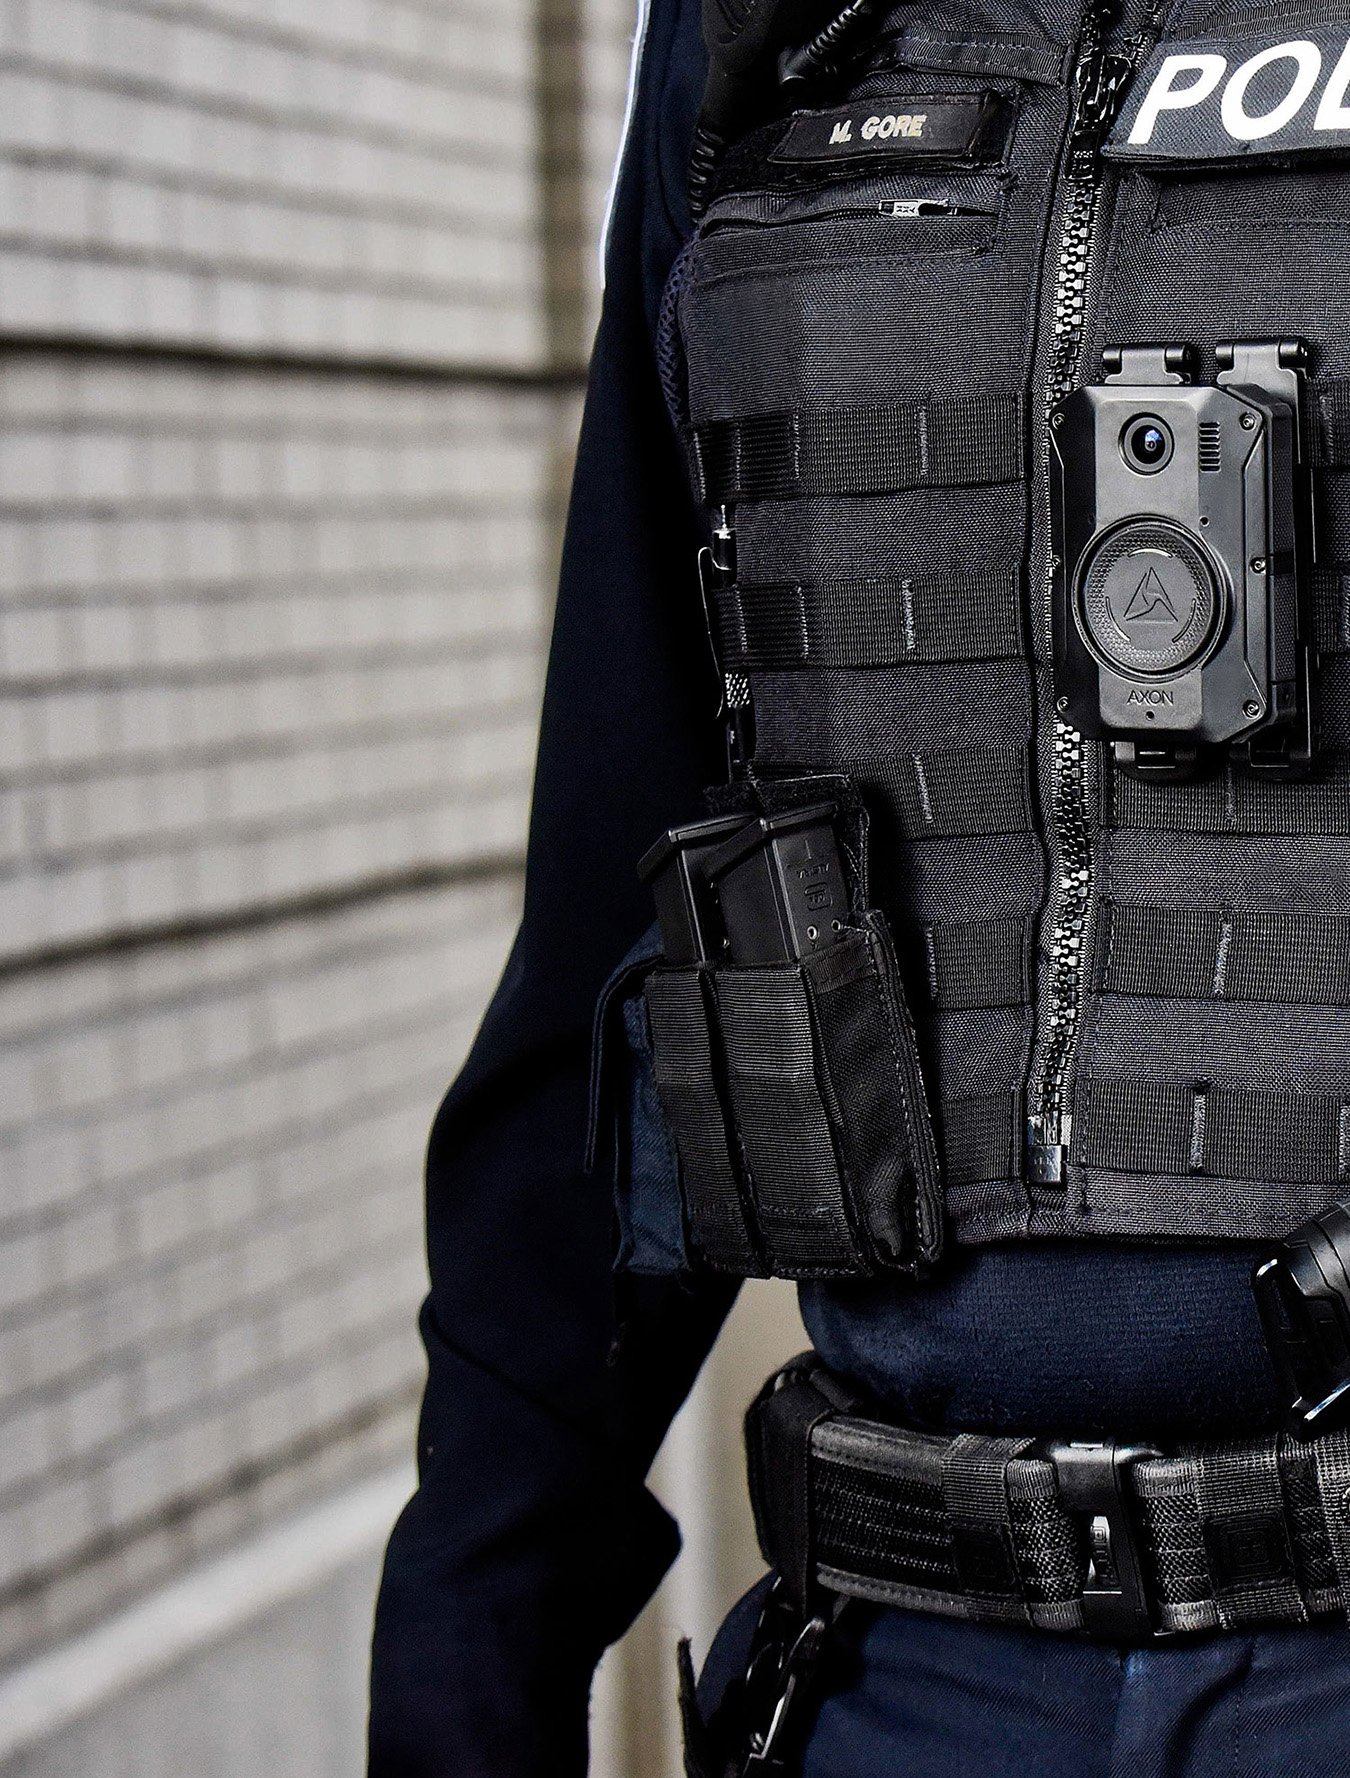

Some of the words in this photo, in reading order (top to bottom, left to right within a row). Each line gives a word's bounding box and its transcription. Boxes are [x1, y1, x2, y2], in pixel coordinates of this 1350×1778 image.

[829, 119, 852, 144] M.
[861, 114, 927, 140] GORE
[1126, 689, 1174, 706] AXON
